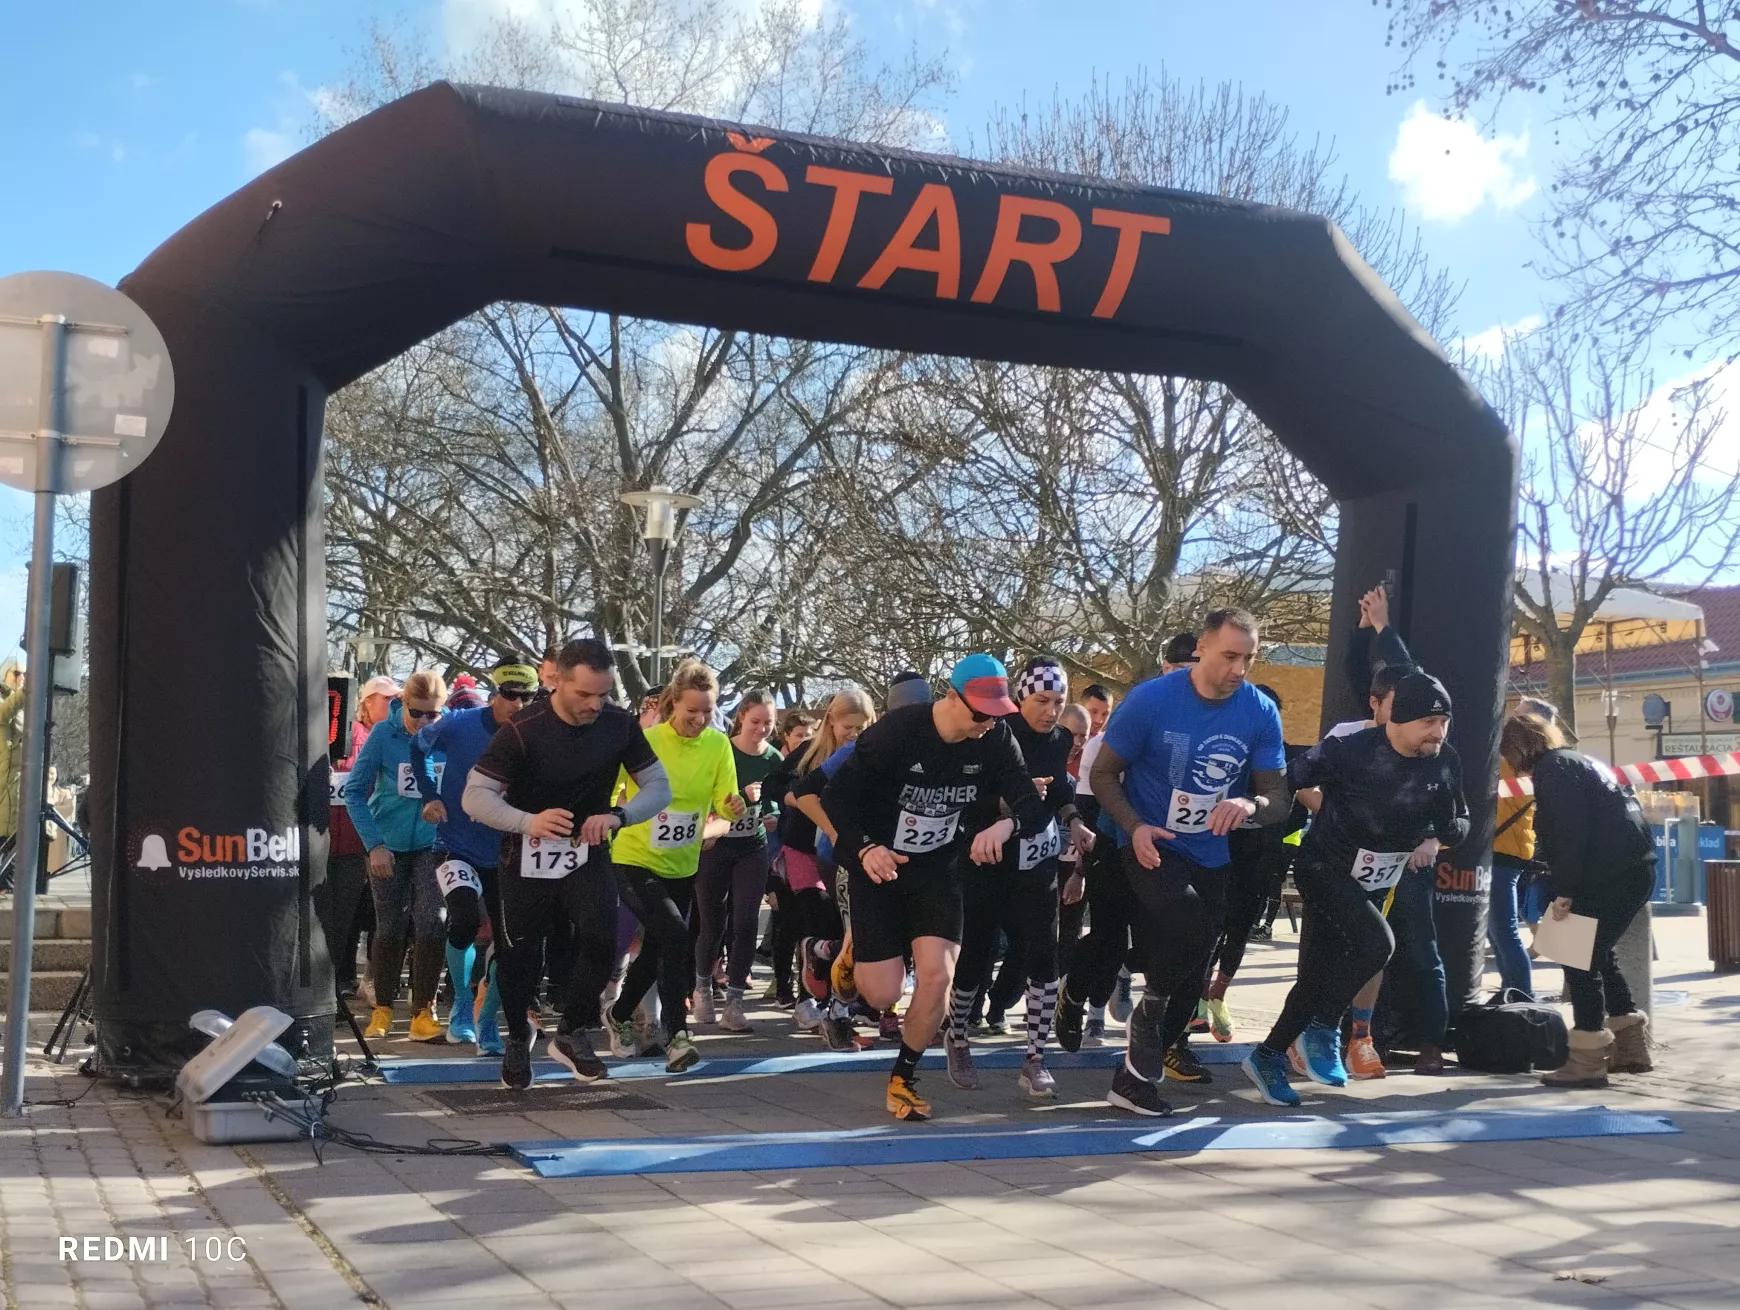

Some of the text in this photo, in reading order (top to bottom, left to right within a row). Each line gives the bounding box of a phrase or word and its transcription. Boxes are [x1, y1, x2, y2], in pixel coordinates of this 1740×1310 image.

[685, 131, 1171, 319] ŠTART
[900, 784, 978, 804] FINISHER
[1175, 807, 1217, 826] 22
[658, 823, 697, 841] 288
[903, 827, 949, 846] 223
[177, 826, 300, 863] SunBell
[1026, 835, 1058, 862] 289
[530, 850, 579, 870] 173
[178, 866, 300, 880] VysledkovyServis.sk
[1357, 864, 1399, 884] 257
